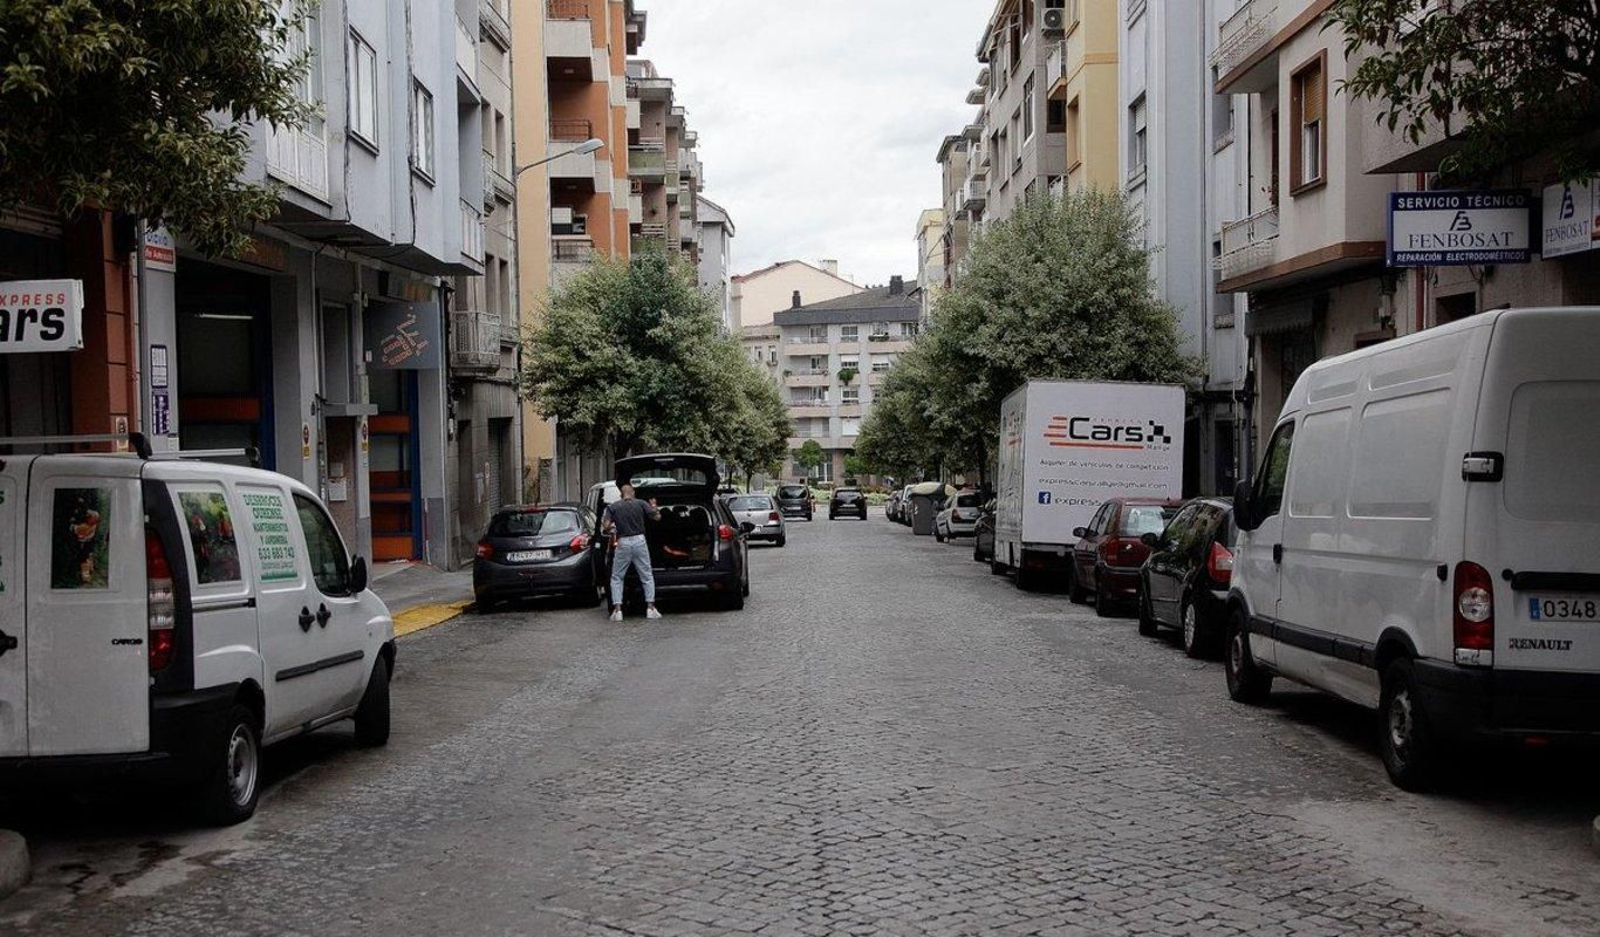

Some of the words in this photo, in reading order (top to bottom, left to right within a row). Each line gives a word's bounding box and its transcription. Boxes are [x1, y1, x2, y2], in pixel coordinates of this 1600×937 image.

[1398, 196, 1460, 209] SERVICIO
[1545, 220, 1589, 244] FENBOSAT
[1409, 232, 1514, 249] FENBOSAT
[1396, 252, 1442, 262] REPARACIÓN
[1069, 417, 1144, 443] Cars
[258, 547, 271, 560] 633
[1543, 600, 1596, 619] 0348
[1509, 638, 1573, 651] RENAULT
